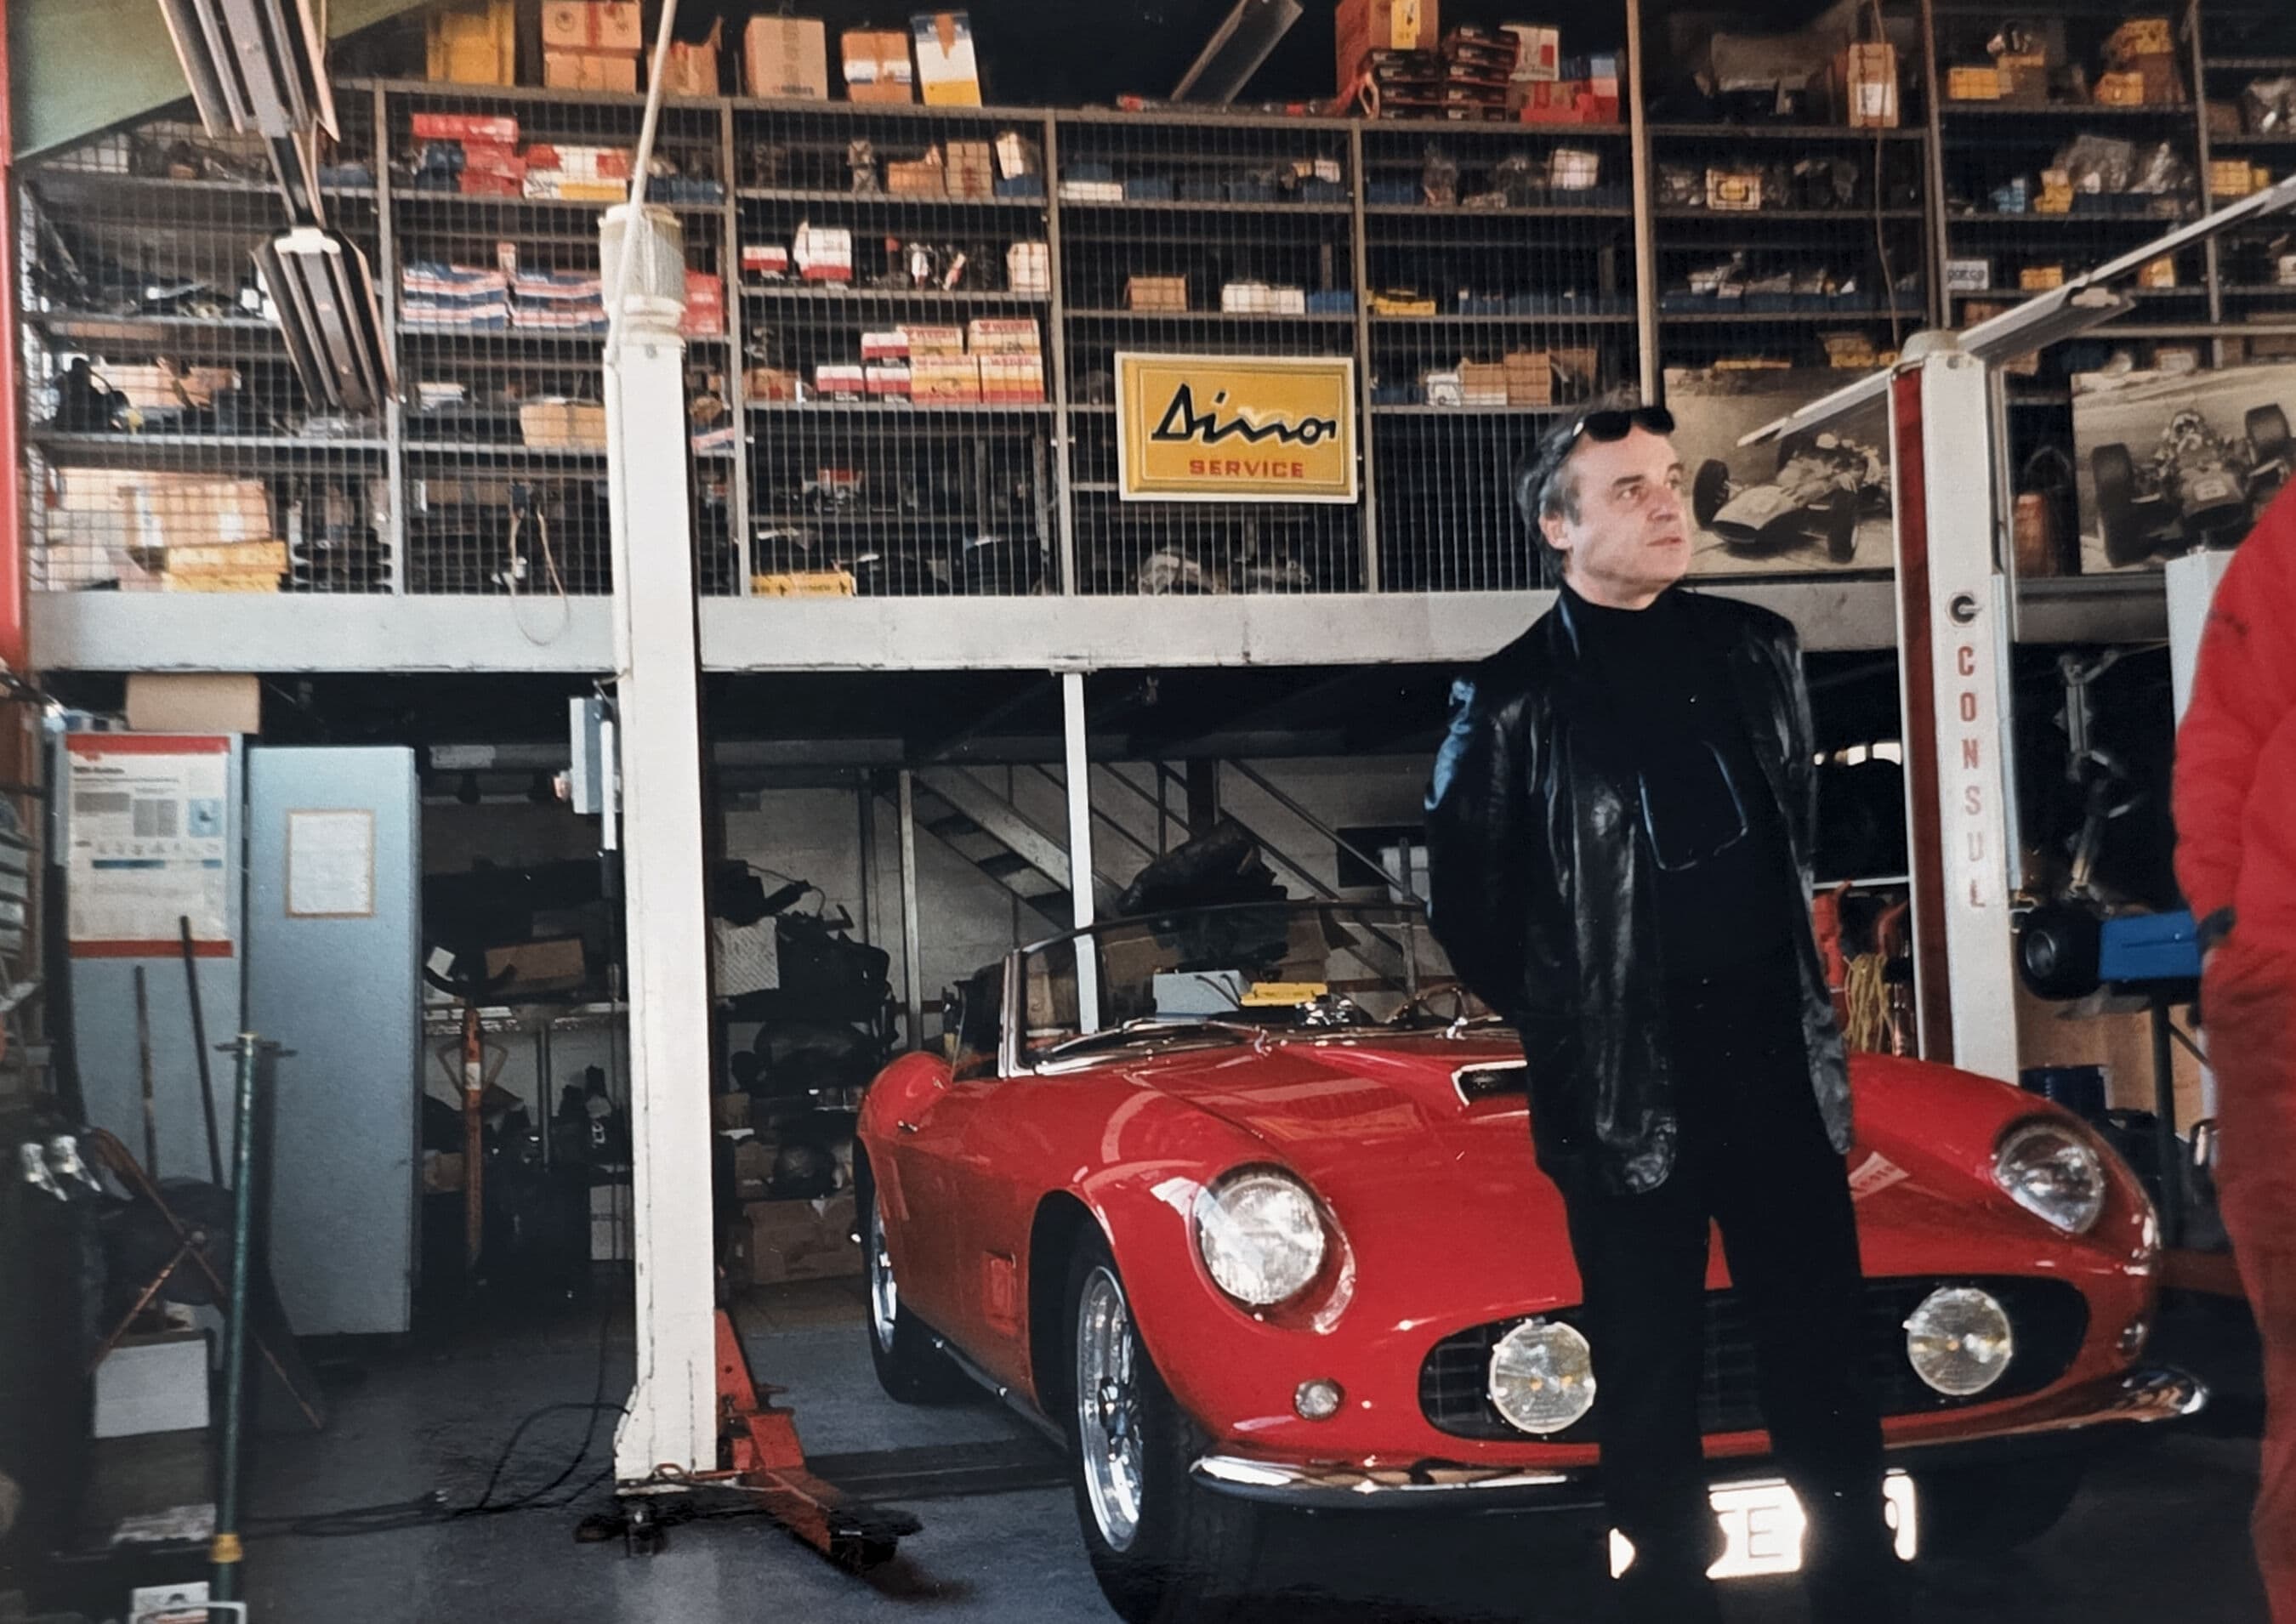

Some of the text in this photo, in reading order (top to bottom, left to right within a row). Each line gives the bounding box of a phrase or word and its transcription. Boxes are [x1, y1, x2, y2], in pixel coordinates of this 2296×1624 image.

[1151, 383, 1336, 446] Dino
[1190, 459, 1304, 479] SERVICE
[1957, 645, 1986, 909] CONSUL
